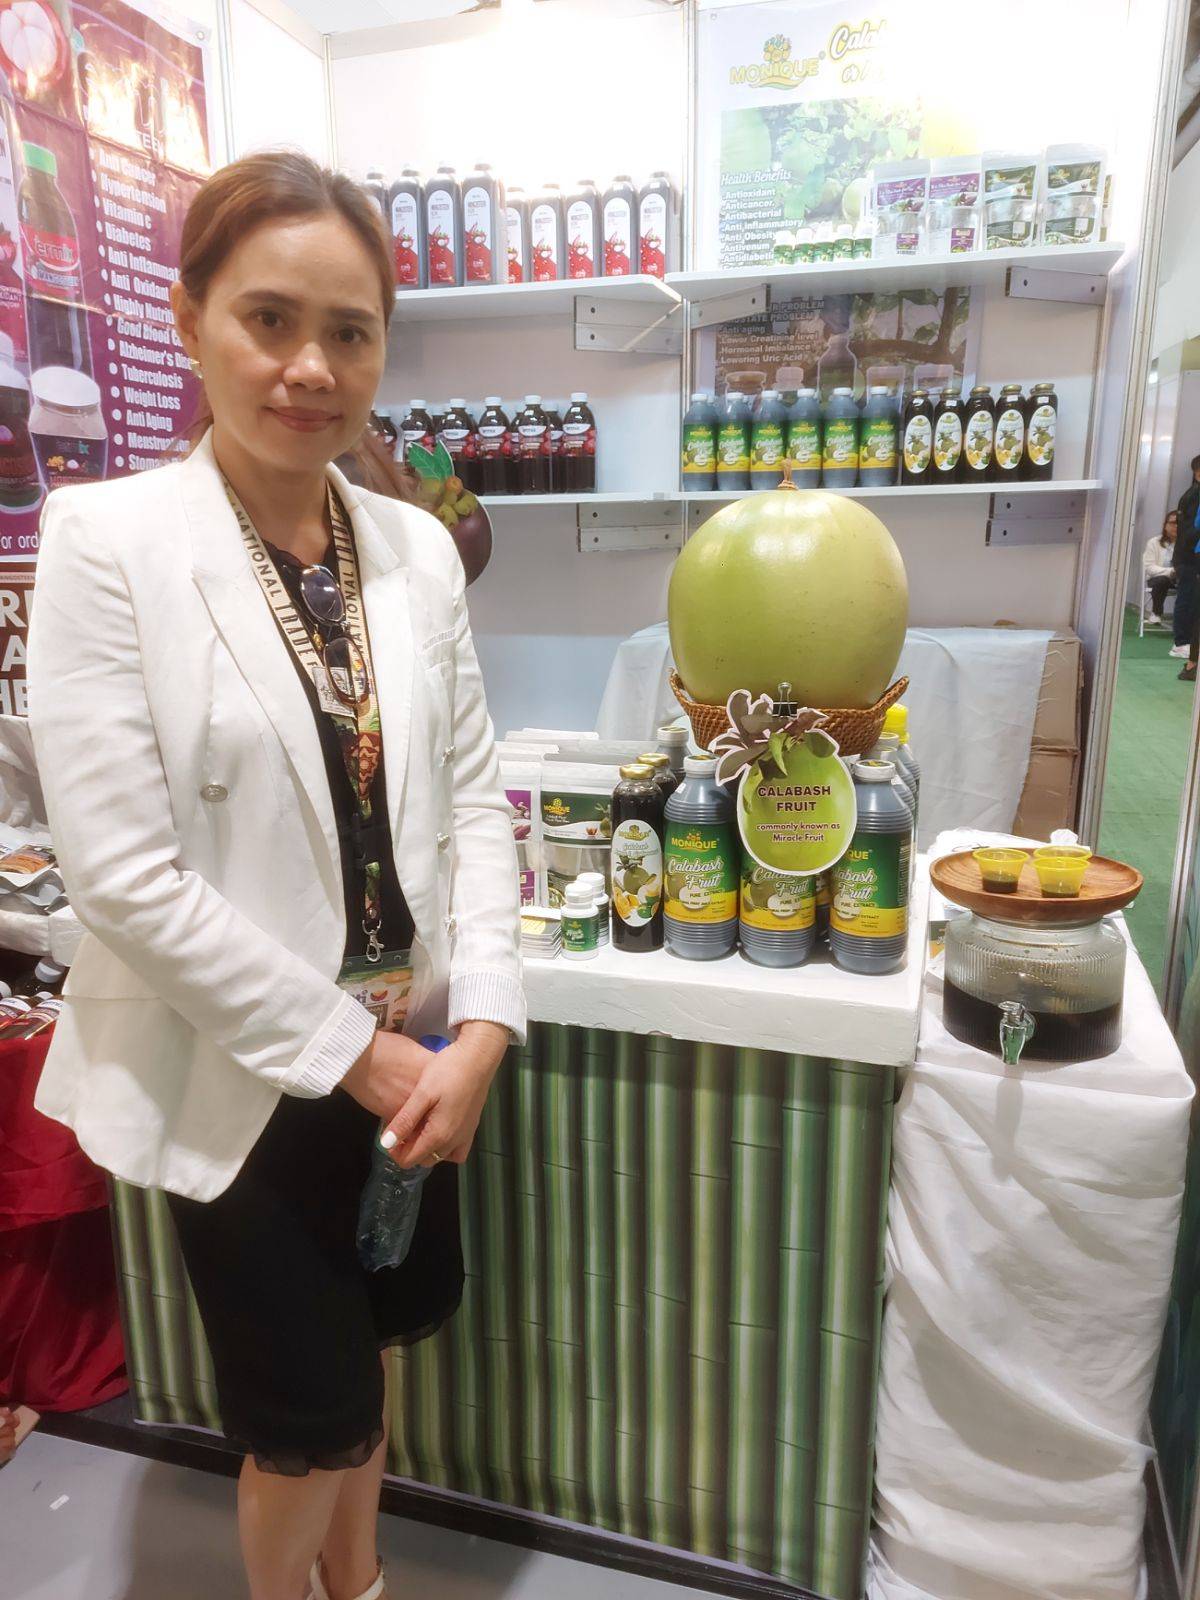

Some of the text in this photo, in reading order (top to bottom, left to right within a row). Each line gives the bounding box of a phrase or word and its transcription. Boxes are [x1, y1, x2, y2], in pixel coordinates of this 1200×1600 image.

[729, 57, 819, 85] MONIQUE
[721, 167, 793, 185] Health Benefits
[101, 172, 167, 214] Hypertension
[726, 189, 777, 200] Antioxidant
[103, 197, 145, 228] Vitamin
[725, 211, 782, 222] Antibacterial
[725, 223, 744, 232] Anti
[105, 222, 152, 252] Diabetes
[725, 233, 743, 242] Anti
[108, 246, 180, 283] Anti Inflammat
[111, 270, 170, 303] Anti Oxidant
[113, 294, 145, 319] Highly
[781, 300, 824, 311] PROBLEM
[770, 311, 816, 322] PROBLEM
[117, 317, 142, 339] Good
[119, 340, 175, 368] Alzheimer's
[721, 343, 811, 354] Hormonal Imbalance
[721, 353, 803, 365] Lowering Uric Acid
[122, 363, 184, 390] Tuberculosis
[124, 386, 182, 411] Weight Loss
[127, 409, 174, 433] Anti Aging
[0, 531, 40, 549] or ord
[275, 601, 316, 662] TRADE
[757, 785, 832, 797] CALABASH
[776, 801, 817, 812] FRUIT
[757, 822, 799, 831] commonly
[801, 822, 829, 830] known
[671, 836, 718, 850] MONIQUE
[774, 833, 825, 842] Miracle Fruit
[667, 855, 725, 876] Calabash
[684, 872, 725, 890] Fruit
[775, 879, 810, 897] Fruit
[839, 881, 878, 902] Fruit
